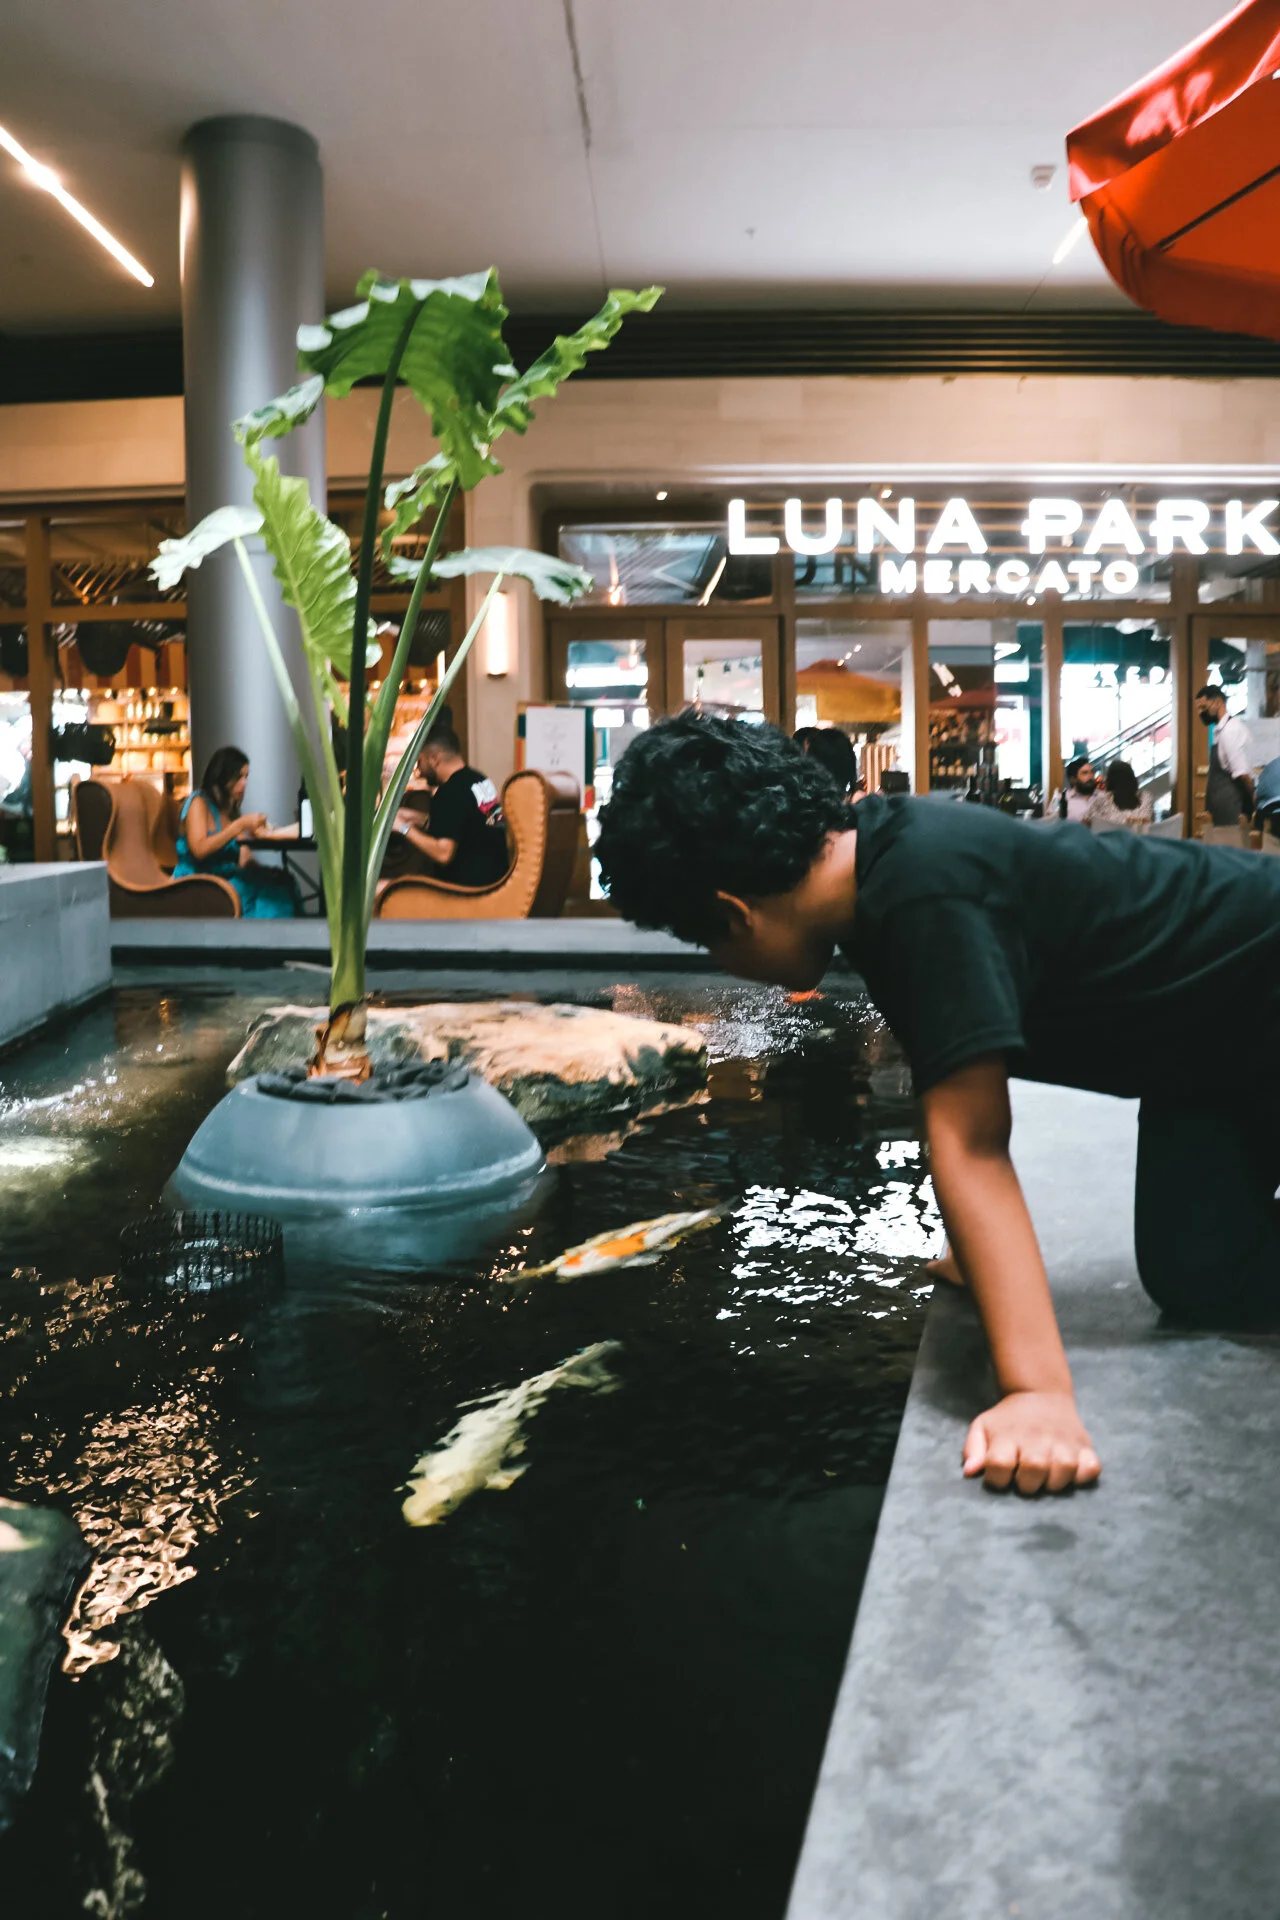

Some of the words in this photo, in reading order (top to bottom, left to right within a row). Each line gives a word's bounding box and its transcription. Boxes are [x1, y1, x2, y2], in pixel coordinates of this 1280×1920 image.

[728, 498, 988, 555] LUNA
[1020, 498, 1280, 555] PARK
[880, 560, 1139, 594] MERCATO
